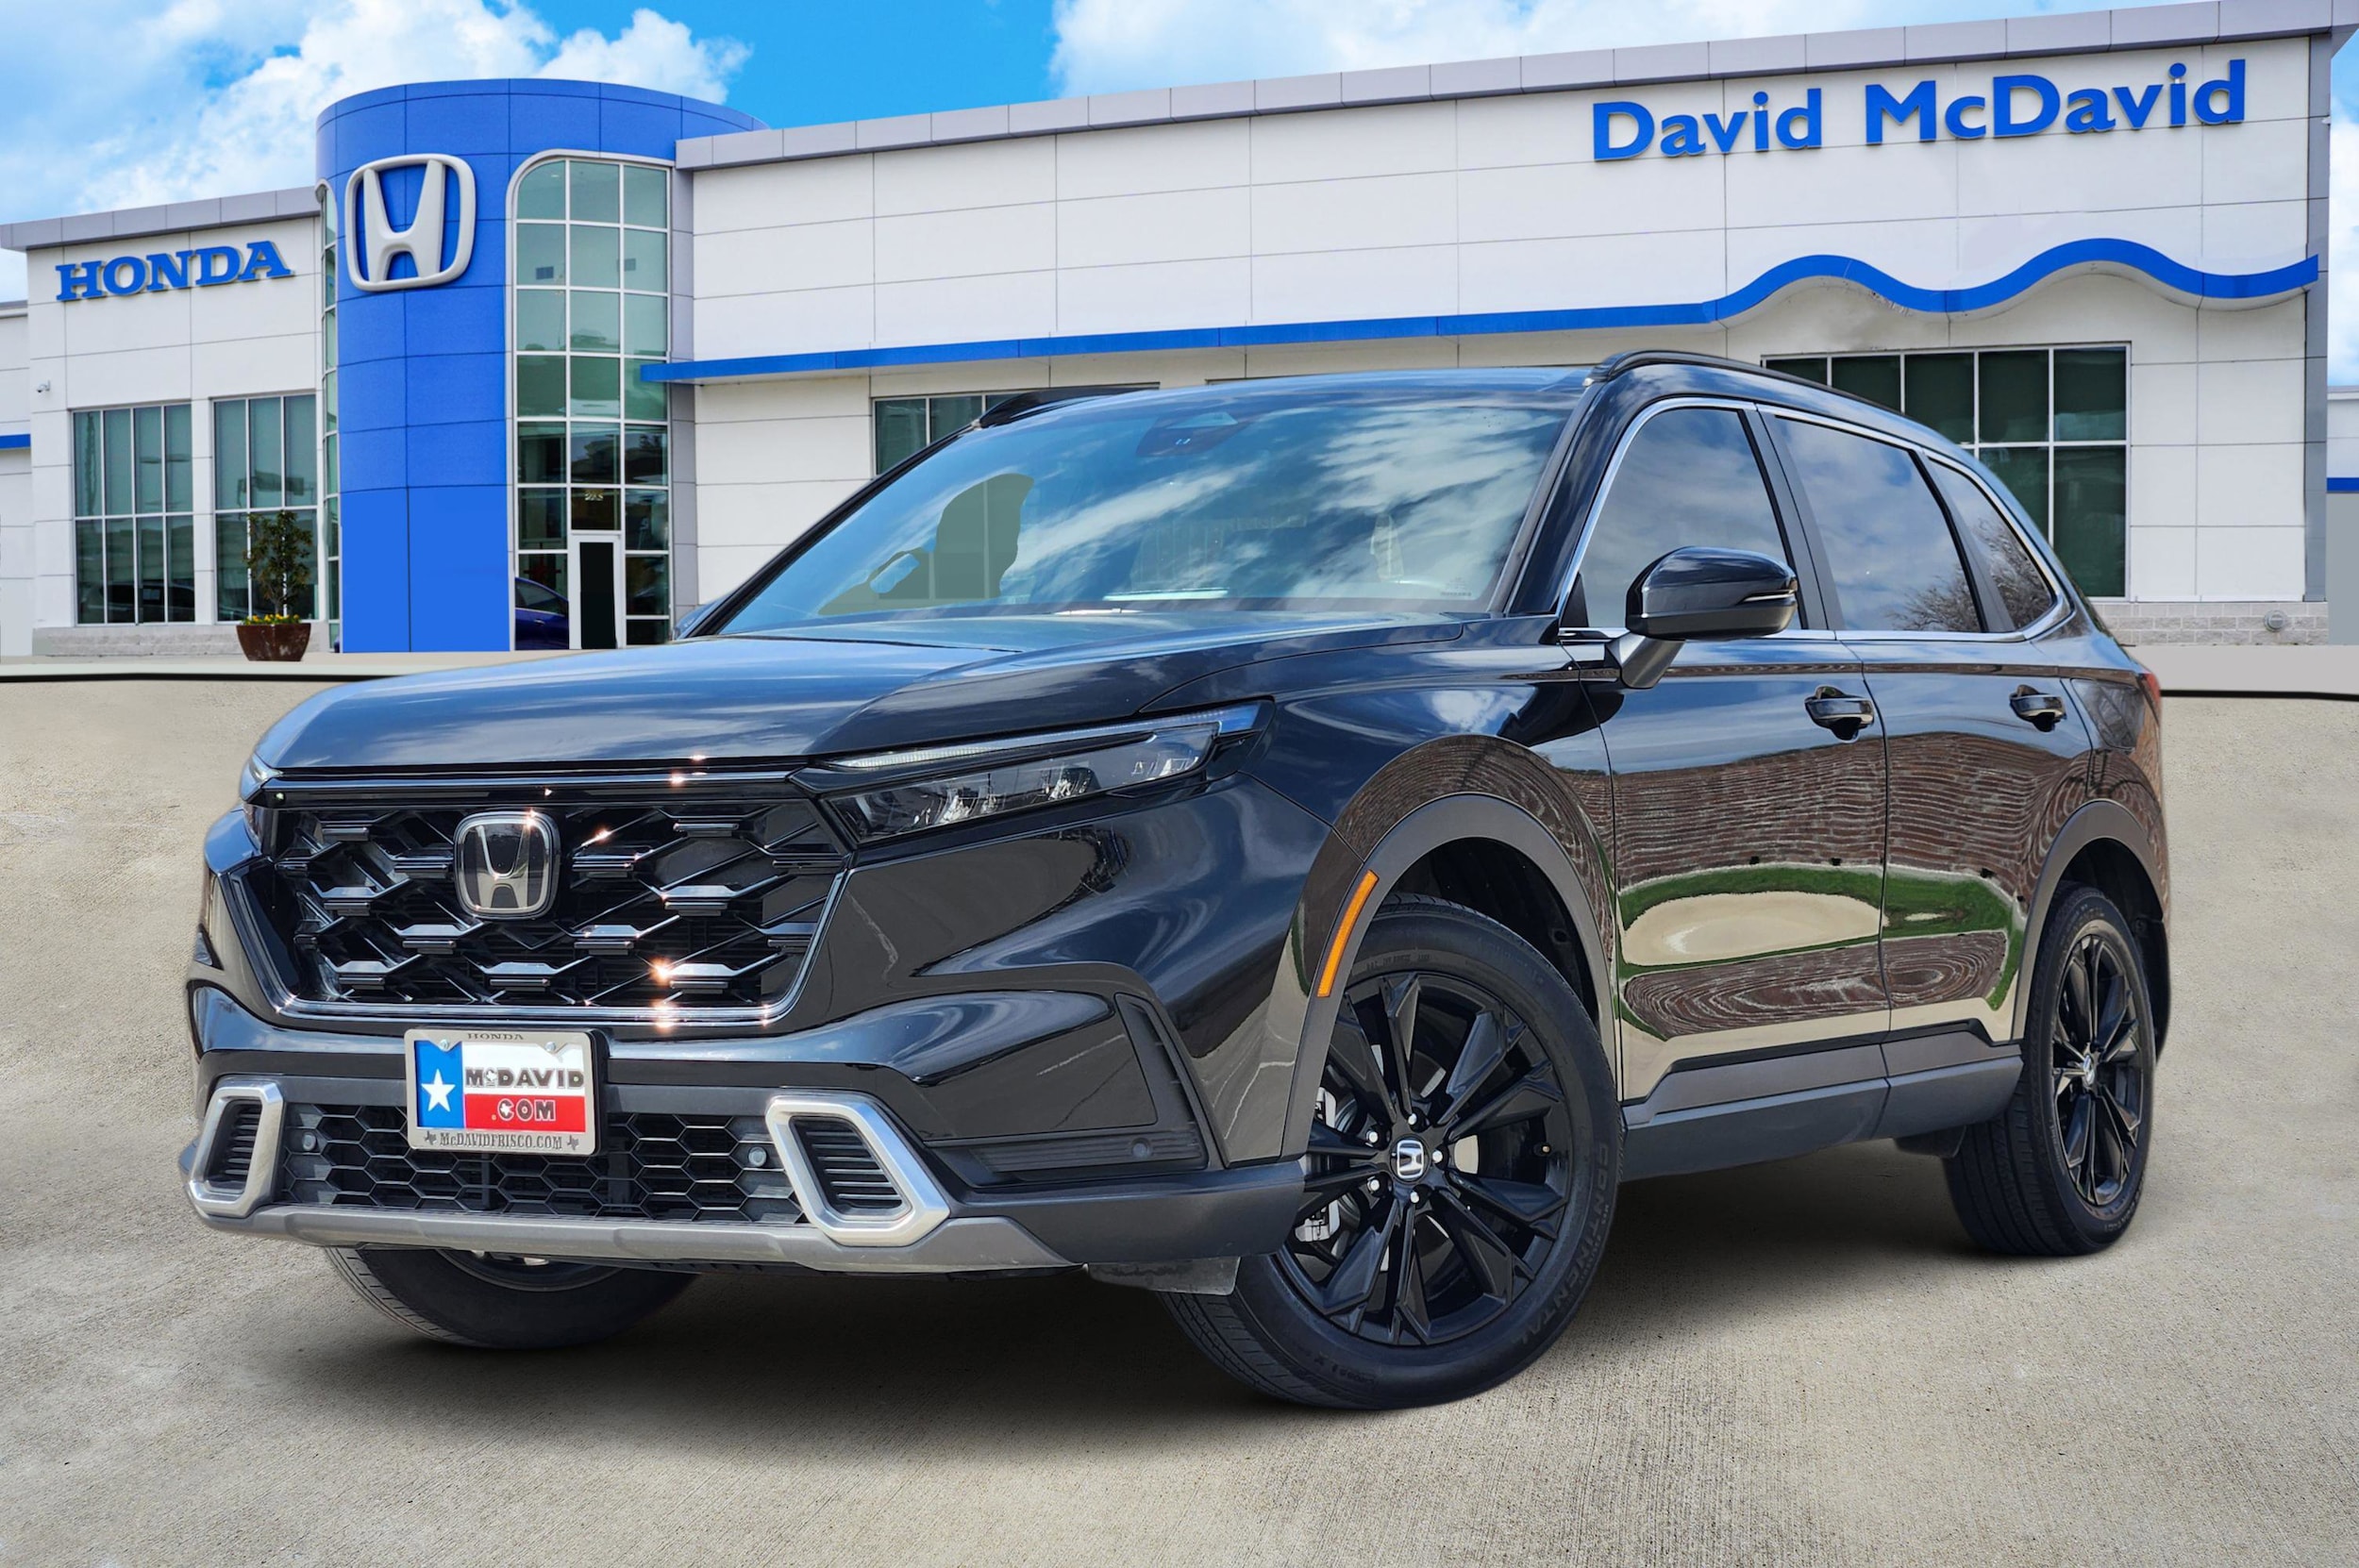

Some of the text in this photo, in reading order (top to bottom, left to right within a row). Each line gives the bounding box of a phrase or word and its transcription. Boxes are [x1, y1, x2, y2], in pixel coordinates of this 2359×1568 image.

[1593, 58, 2246, 161] David McDavid
[55, 240, 293, 302] HONDA
[466, 1032, 525, 1042] HONDA
